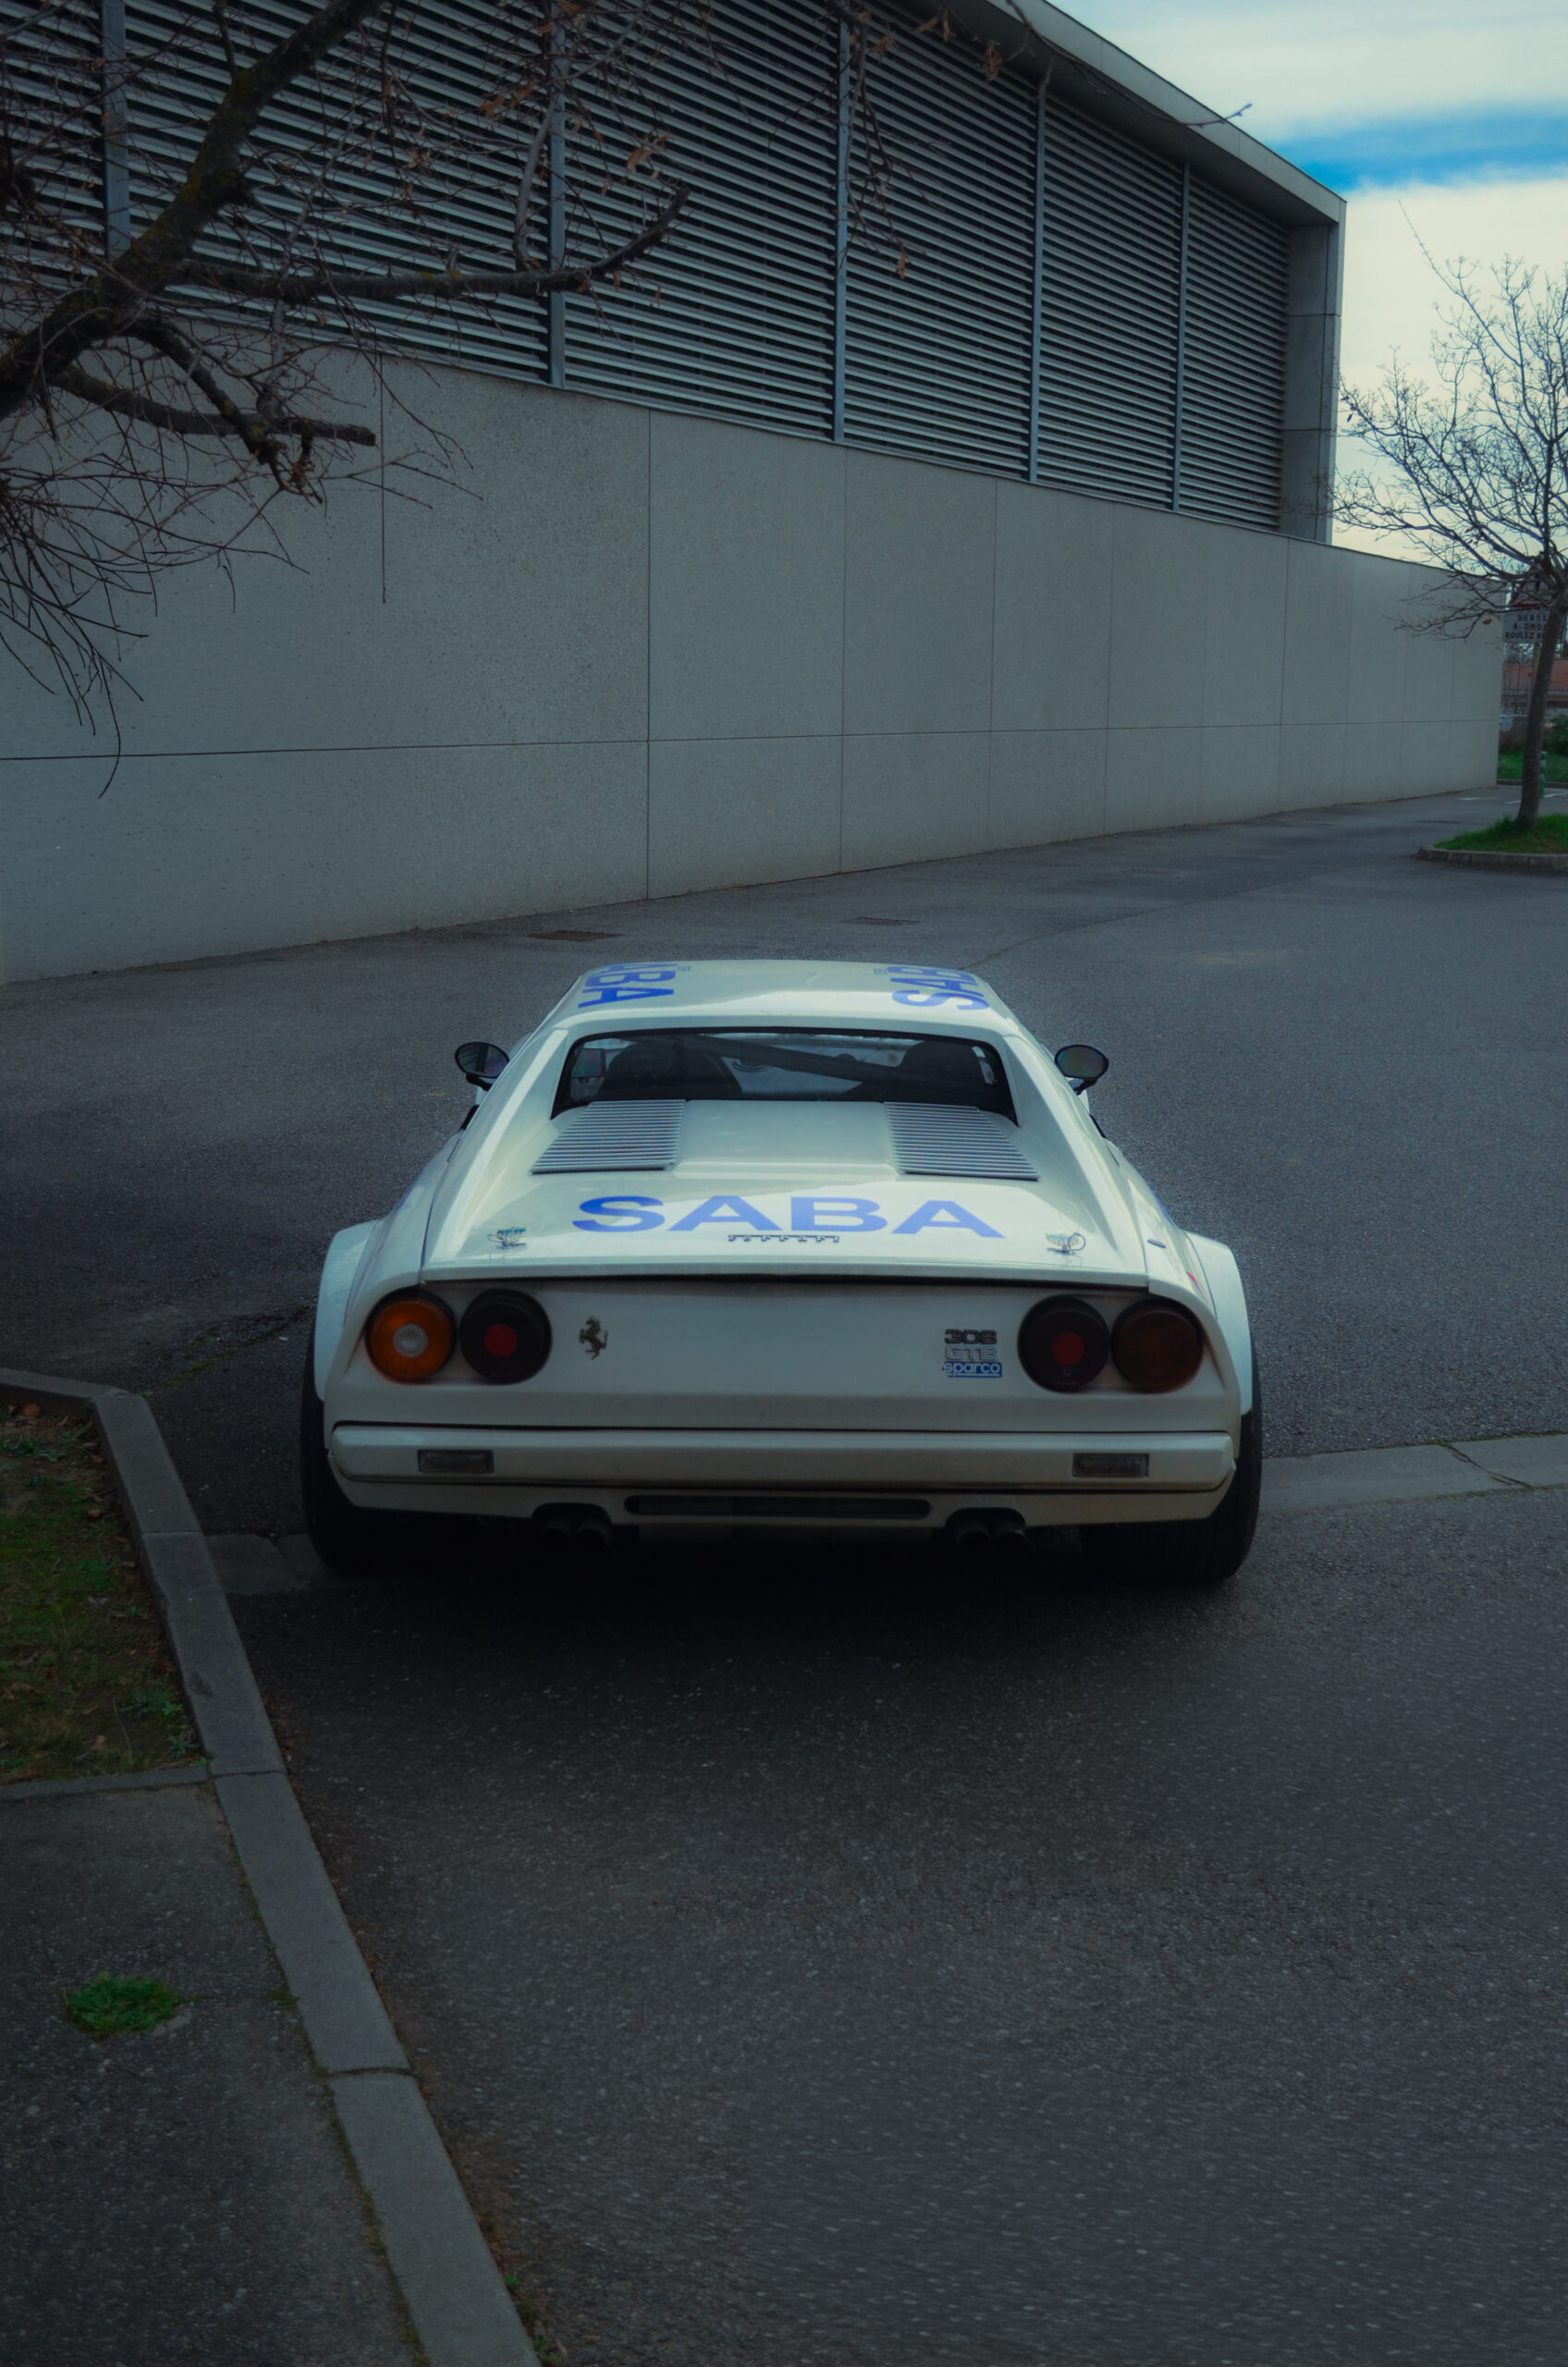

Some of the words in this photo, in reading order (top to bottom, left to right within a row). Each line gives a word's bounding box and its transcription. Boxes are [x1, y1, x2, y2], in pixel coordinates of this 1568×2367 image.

[571, 1195, 1005, 1239] SABA
[944, 1329, 998, 1344] 308
[943, 1362, 1001, 1377] sparco
